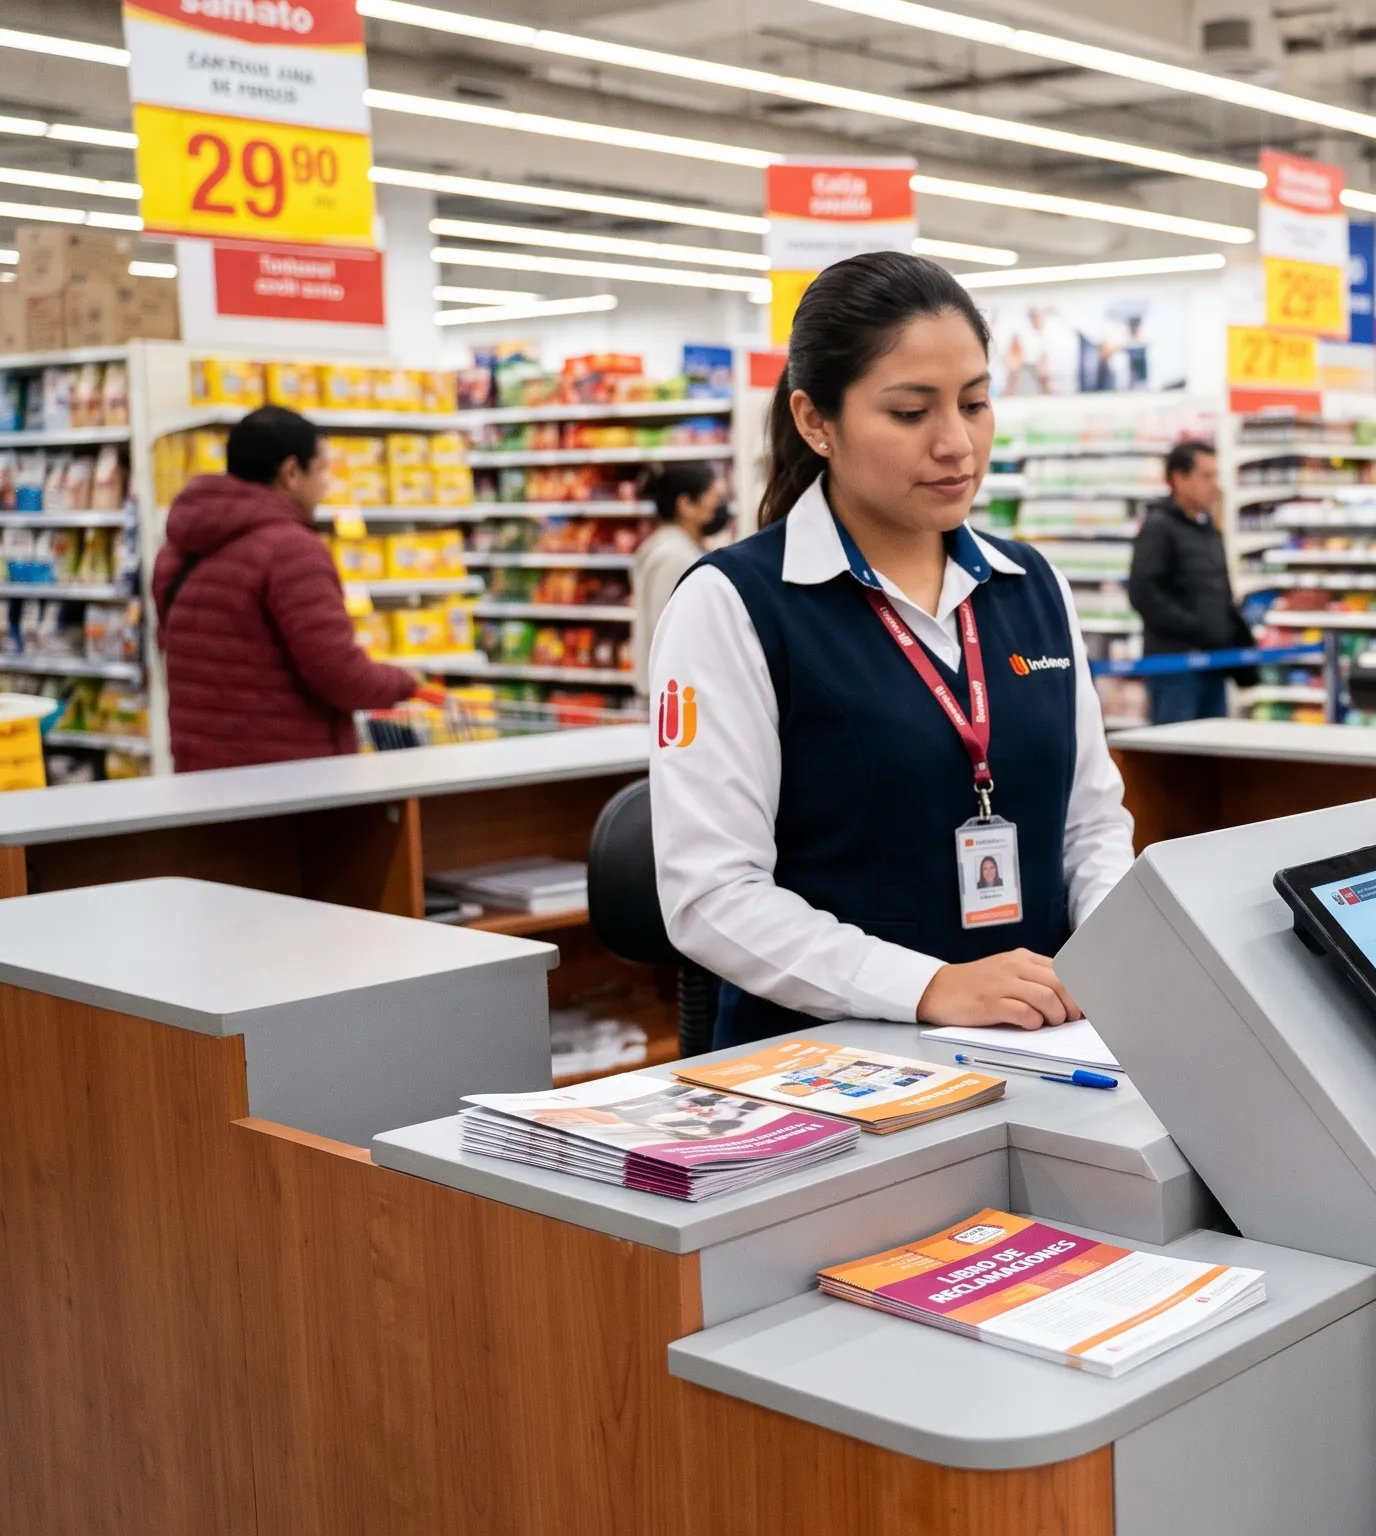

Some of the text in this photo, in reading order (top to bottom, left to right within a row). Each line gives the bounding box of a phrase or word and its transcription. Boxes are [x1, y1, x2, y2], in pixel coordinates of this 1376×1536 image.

[187, 132, 285, 219] 29
[928, 1239, 1077, 1304] RECLAMACIONES
[937, 1247, 1026, 1285] LIBRO DE
